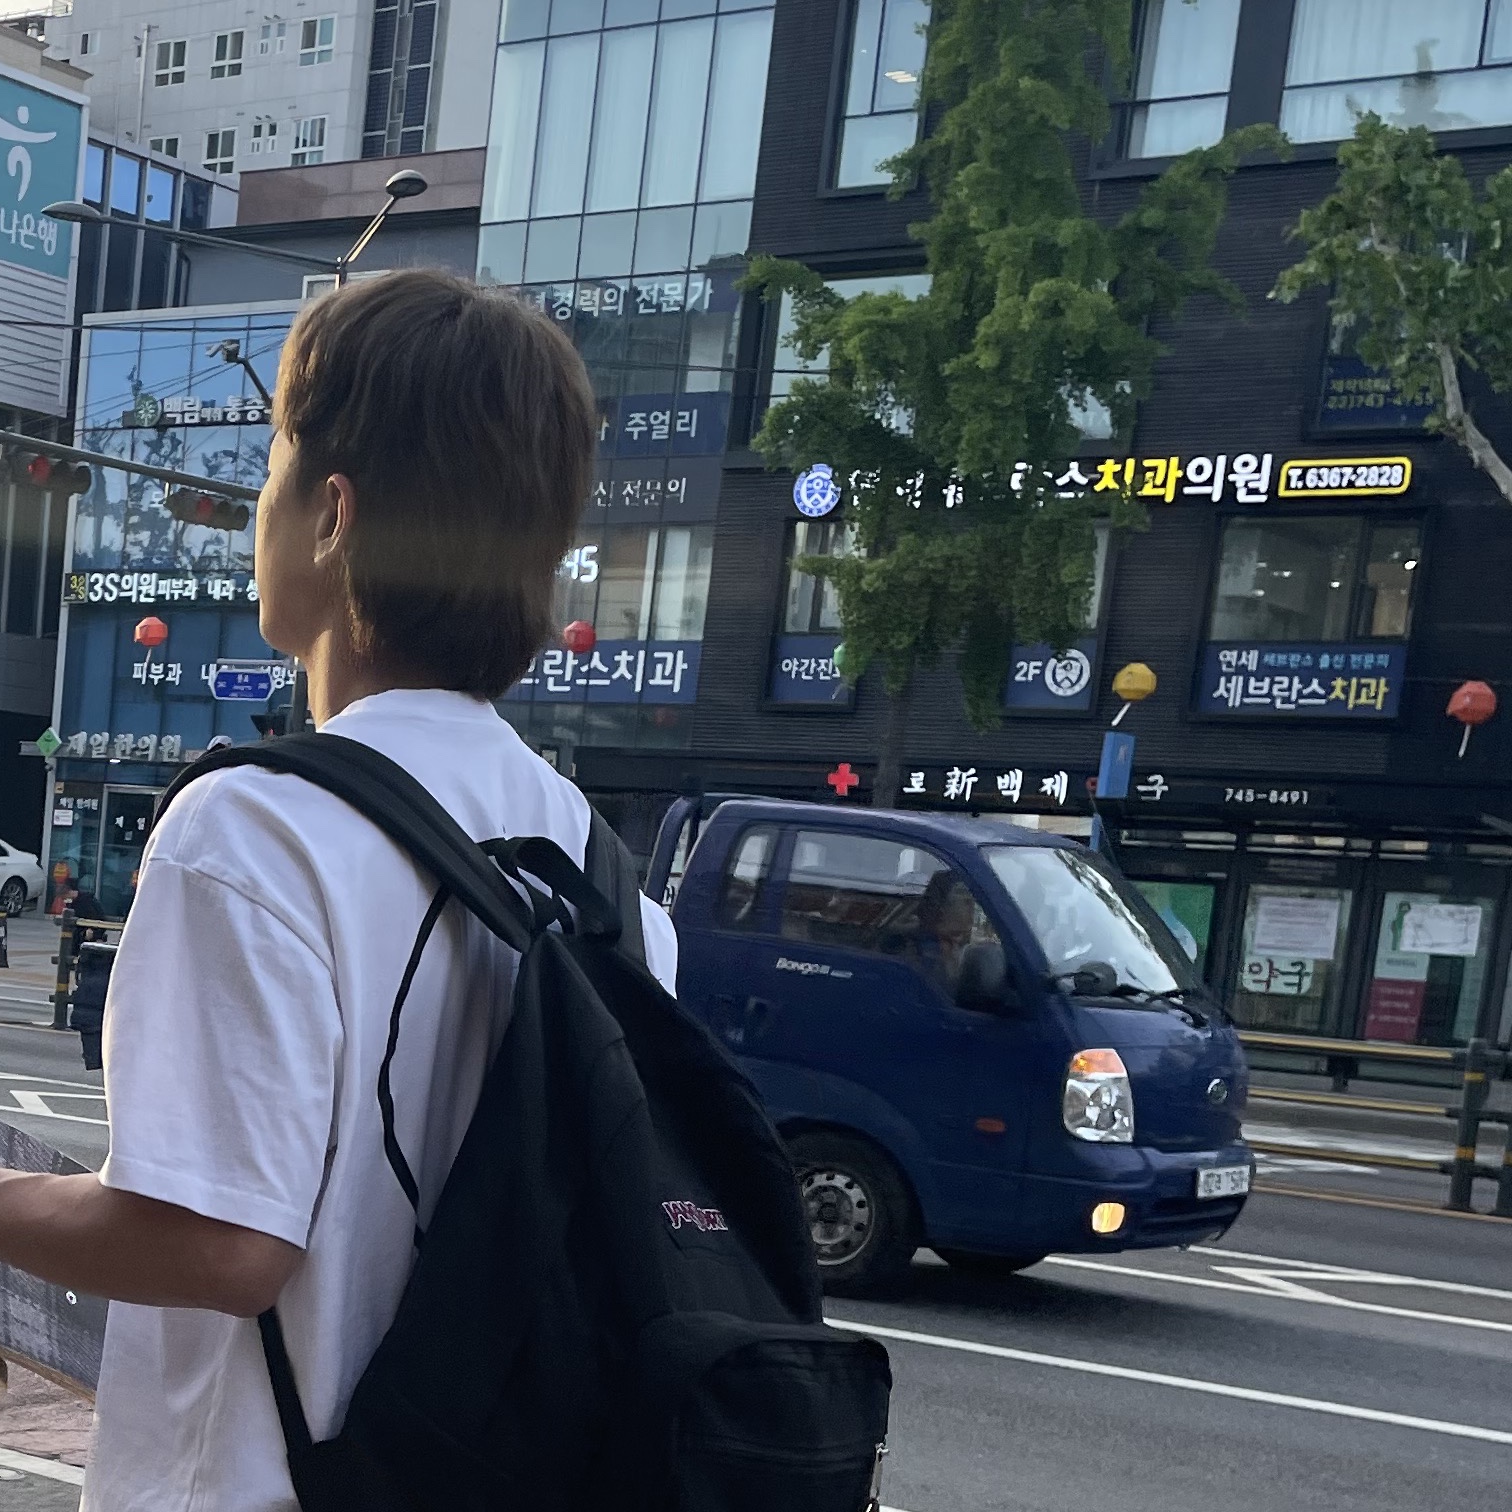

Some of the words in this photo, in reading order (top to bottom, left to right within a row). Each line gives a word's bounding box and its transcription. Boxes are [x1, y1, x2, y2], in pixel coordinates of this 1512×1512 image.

[552, 285, 626, 321] 경력의
[637, 277, 713, 315] 전문가
[624, 408, 698, 441] 주얼리
[132, 662, 182, 685] 피부과
[1014, 660, 1043, 682] 2F
[1219, 650, 1259, 672] 연세
[1212, 675, 1389, 711] 세브란스치과
